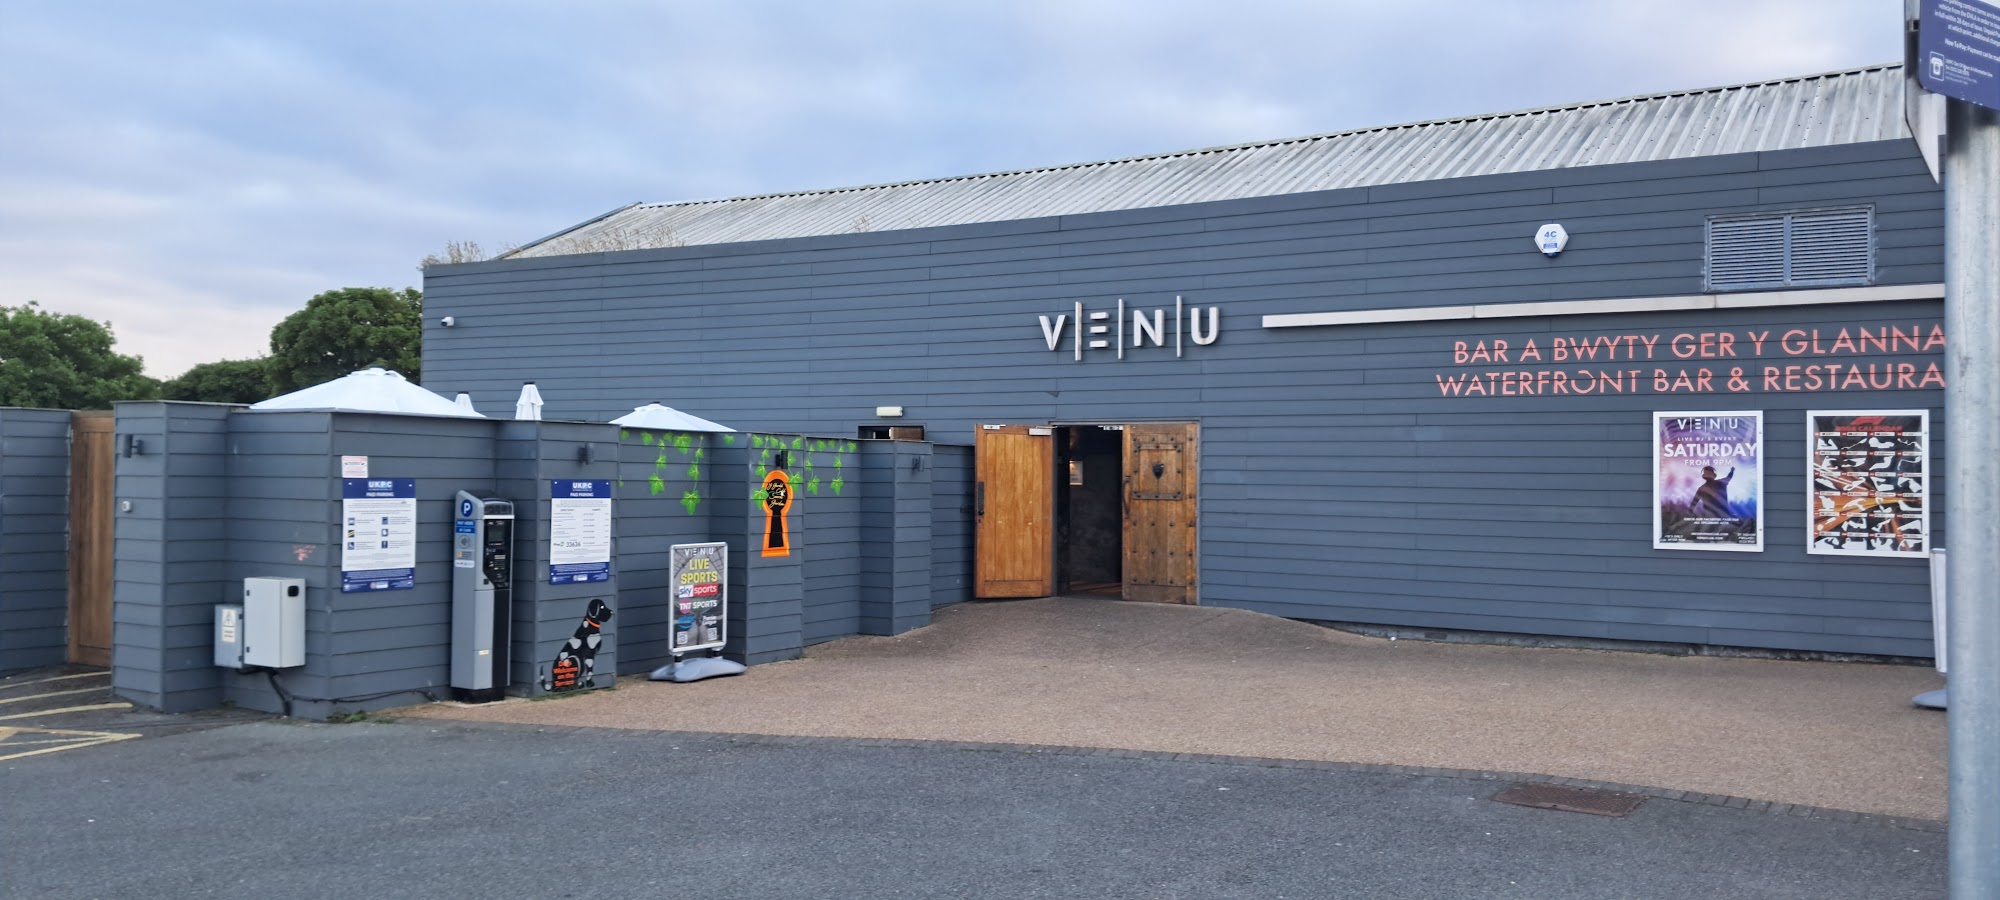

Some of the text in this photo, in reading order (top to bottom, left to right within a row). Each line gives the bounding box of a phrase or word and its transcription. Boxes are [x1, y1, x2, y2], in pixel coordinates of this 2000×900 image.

[1039, 304, 1219, 352] VENU
[1455, 324, 1945, 364] BAR A BWYTY GER Y GLANNA
[1436, 362, 1945, 397] WATERFRONT BAR & RESTAURA
[1677, 418, 1738, 430] VENU
[1664, 442, 1757, 458] SATURDAY
[464, 502, 470, 514] P
[684, 548, 714, 556] VENU
[690, 558, 710, 570] LIVE
[681, 571, 718, 584] SPORTS
[680, 585, 718, 596] sky sports
[692, 600, 718, 609] SPORTS
